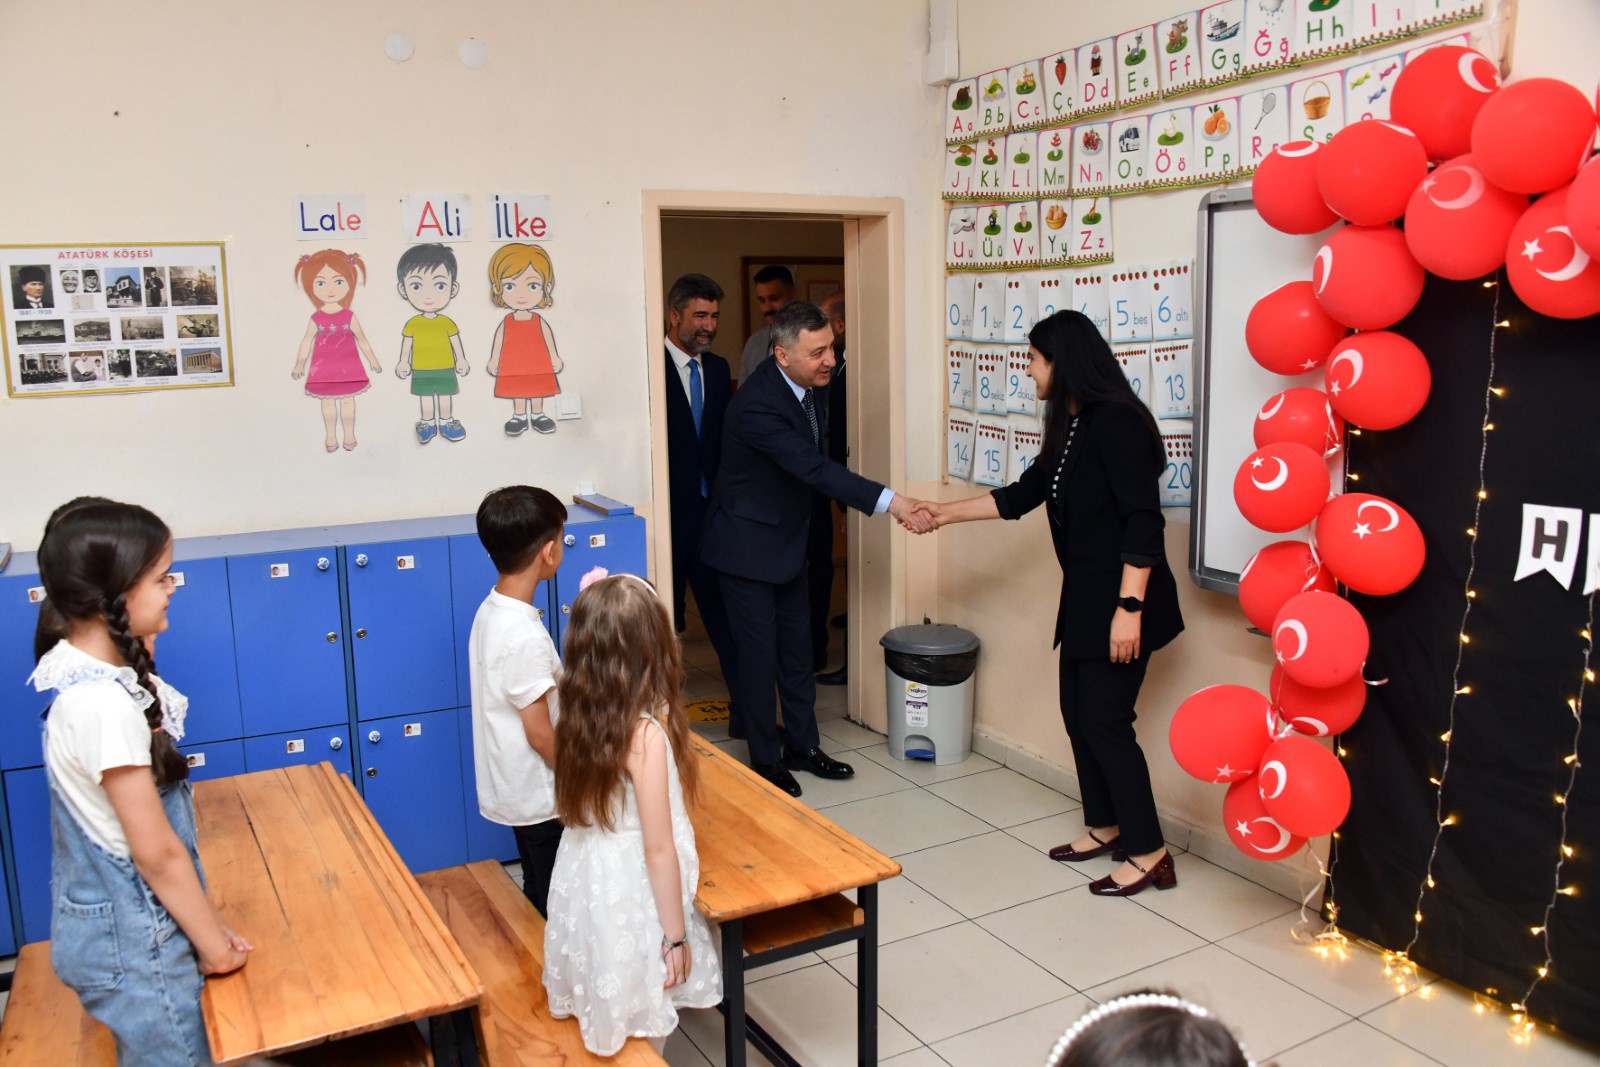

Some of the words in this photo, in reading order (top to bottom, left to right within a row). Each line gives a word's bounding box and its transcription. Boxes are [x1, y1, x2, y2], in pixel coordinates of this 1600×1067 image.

[300, 202, 361, 231] Lale
[416, 201, 461, 236] Ali
[58, 249, 109, 259] ATATÜRK
[114, 248, 153, 261] KÖŞESİ
[949, 304, 960, 326] 0
[980, 305, 988, 328] 1
[1012, 305, 1024, 328] 2
[1117, 300, 1129, 326] 5
[1158, 295, 1171, 323] 6
[952, 373, 960, 394] 7
[980, 376, 990, 399] 8
[1009, 374, 1019, 397] 9
[1165, 374, 1186, 402] 13
[954, 443, 969, 466] 14
[984, 449, 1000, 473] 15
[1167, 462, 1191, 489] 20
